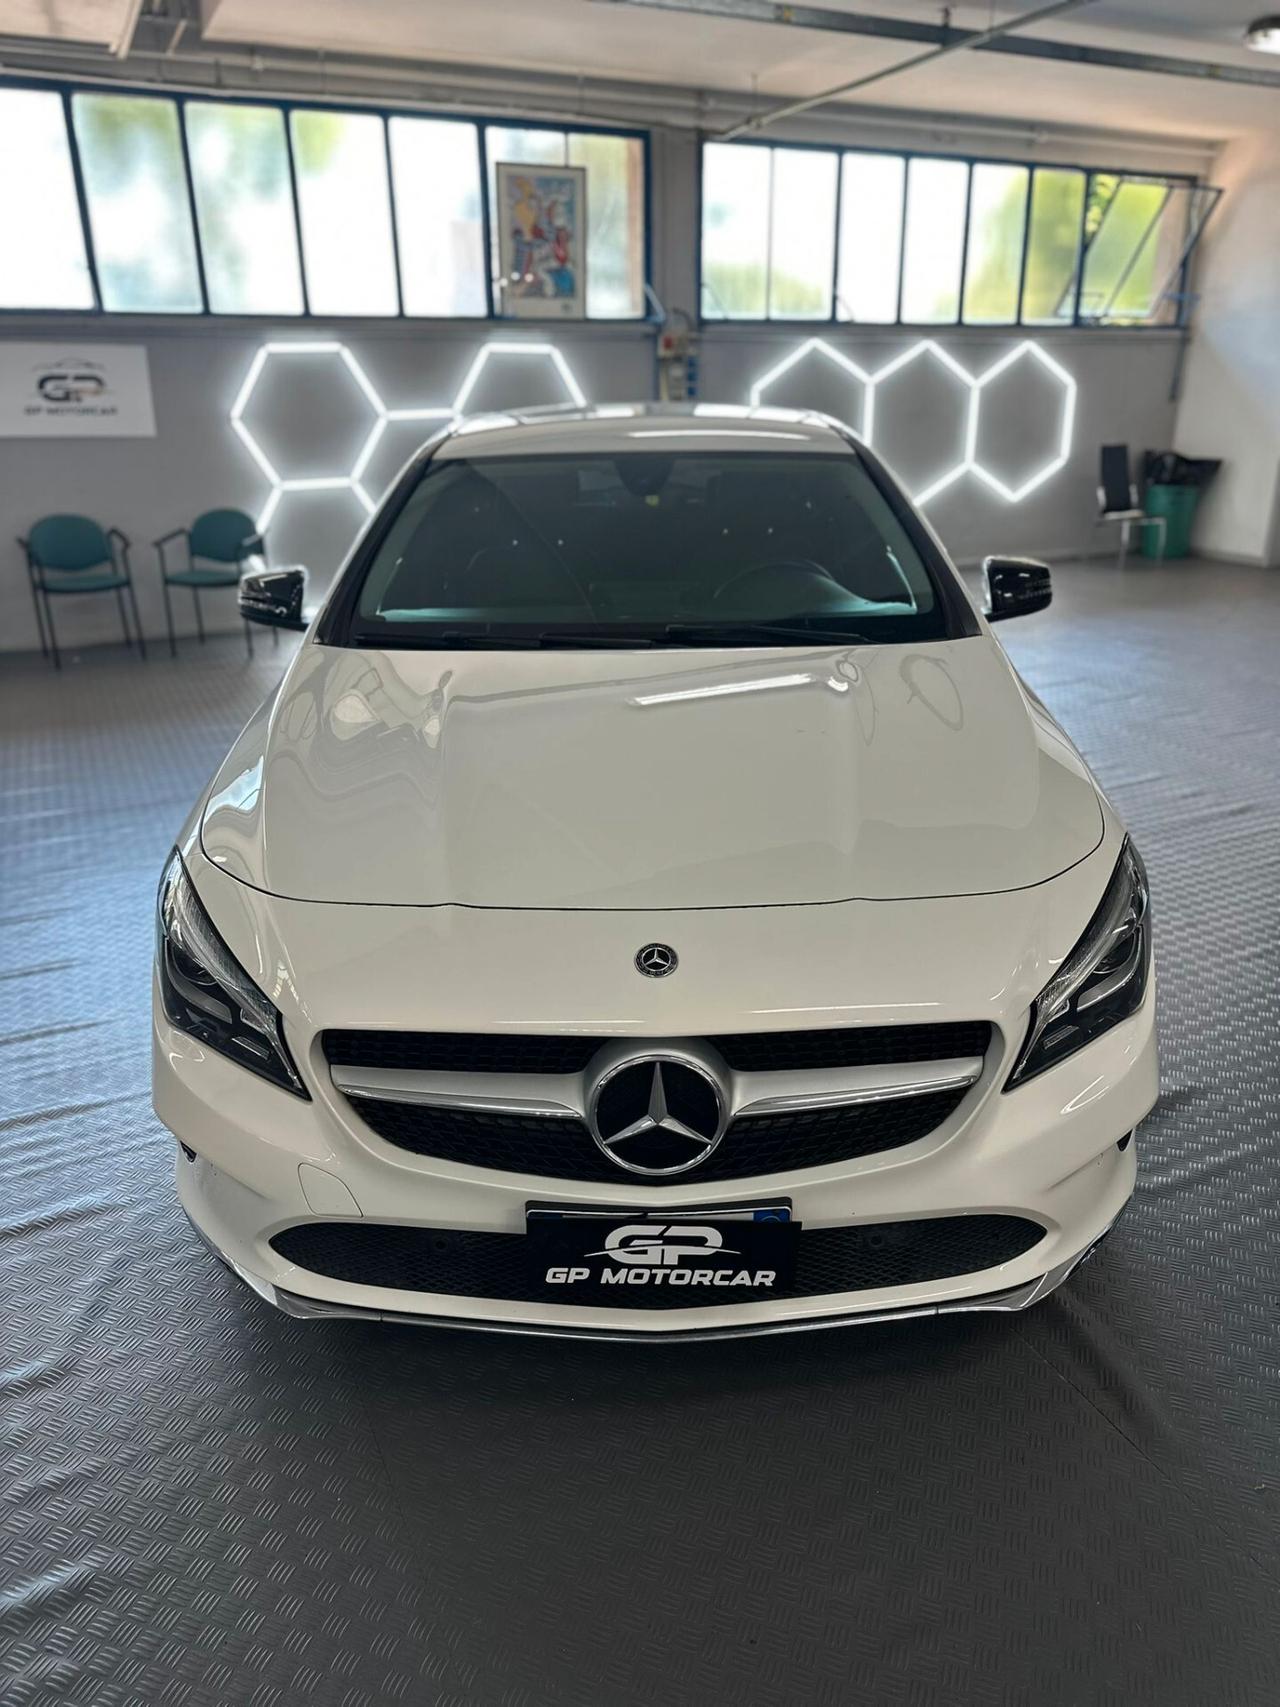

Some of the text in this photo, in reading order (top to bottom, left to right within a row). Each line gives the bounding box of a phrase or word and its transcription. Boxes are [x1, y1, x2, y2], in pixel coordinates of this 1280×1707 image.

[37, 374, 105, 403] GP
[604, 1224, 723, 1265] GP
[545, 1267, 776, 1287] GP MOTORCAR
